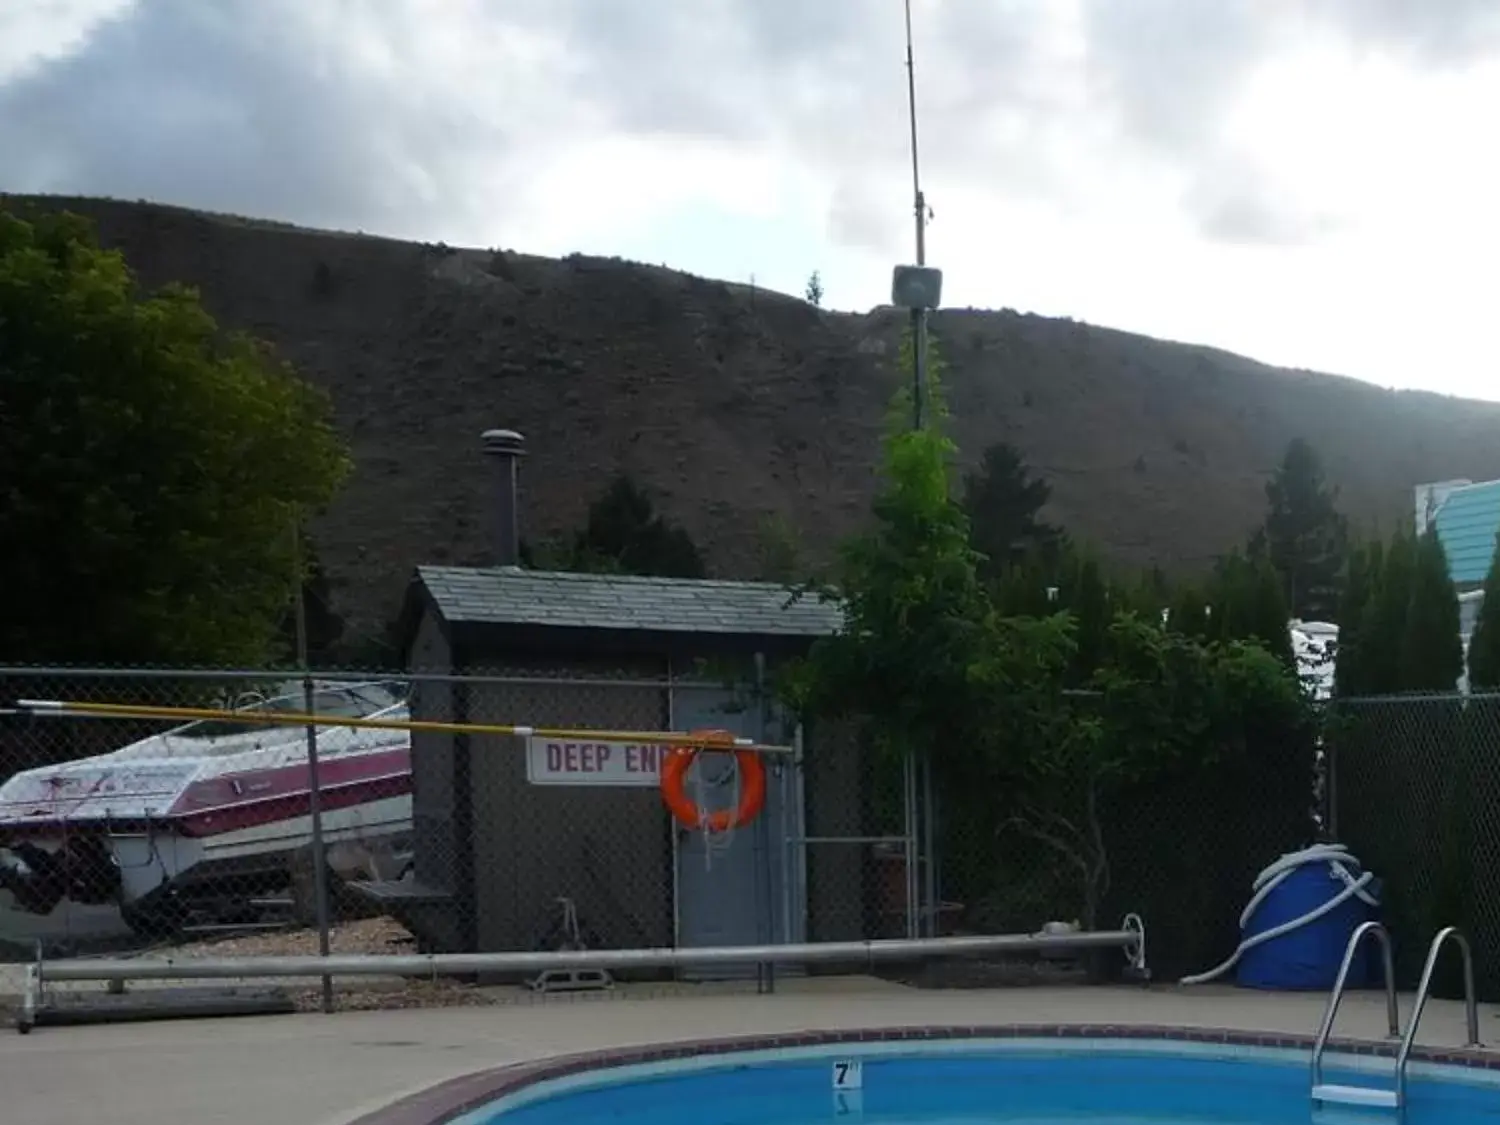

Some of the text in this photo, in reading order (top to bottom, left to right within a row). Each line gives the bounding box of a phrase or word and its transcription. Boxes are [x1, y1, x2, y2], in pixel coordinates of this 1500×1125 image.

[546, 742, 670, 773] DEEP EN
[835, 1063, 849, 1085] 7
